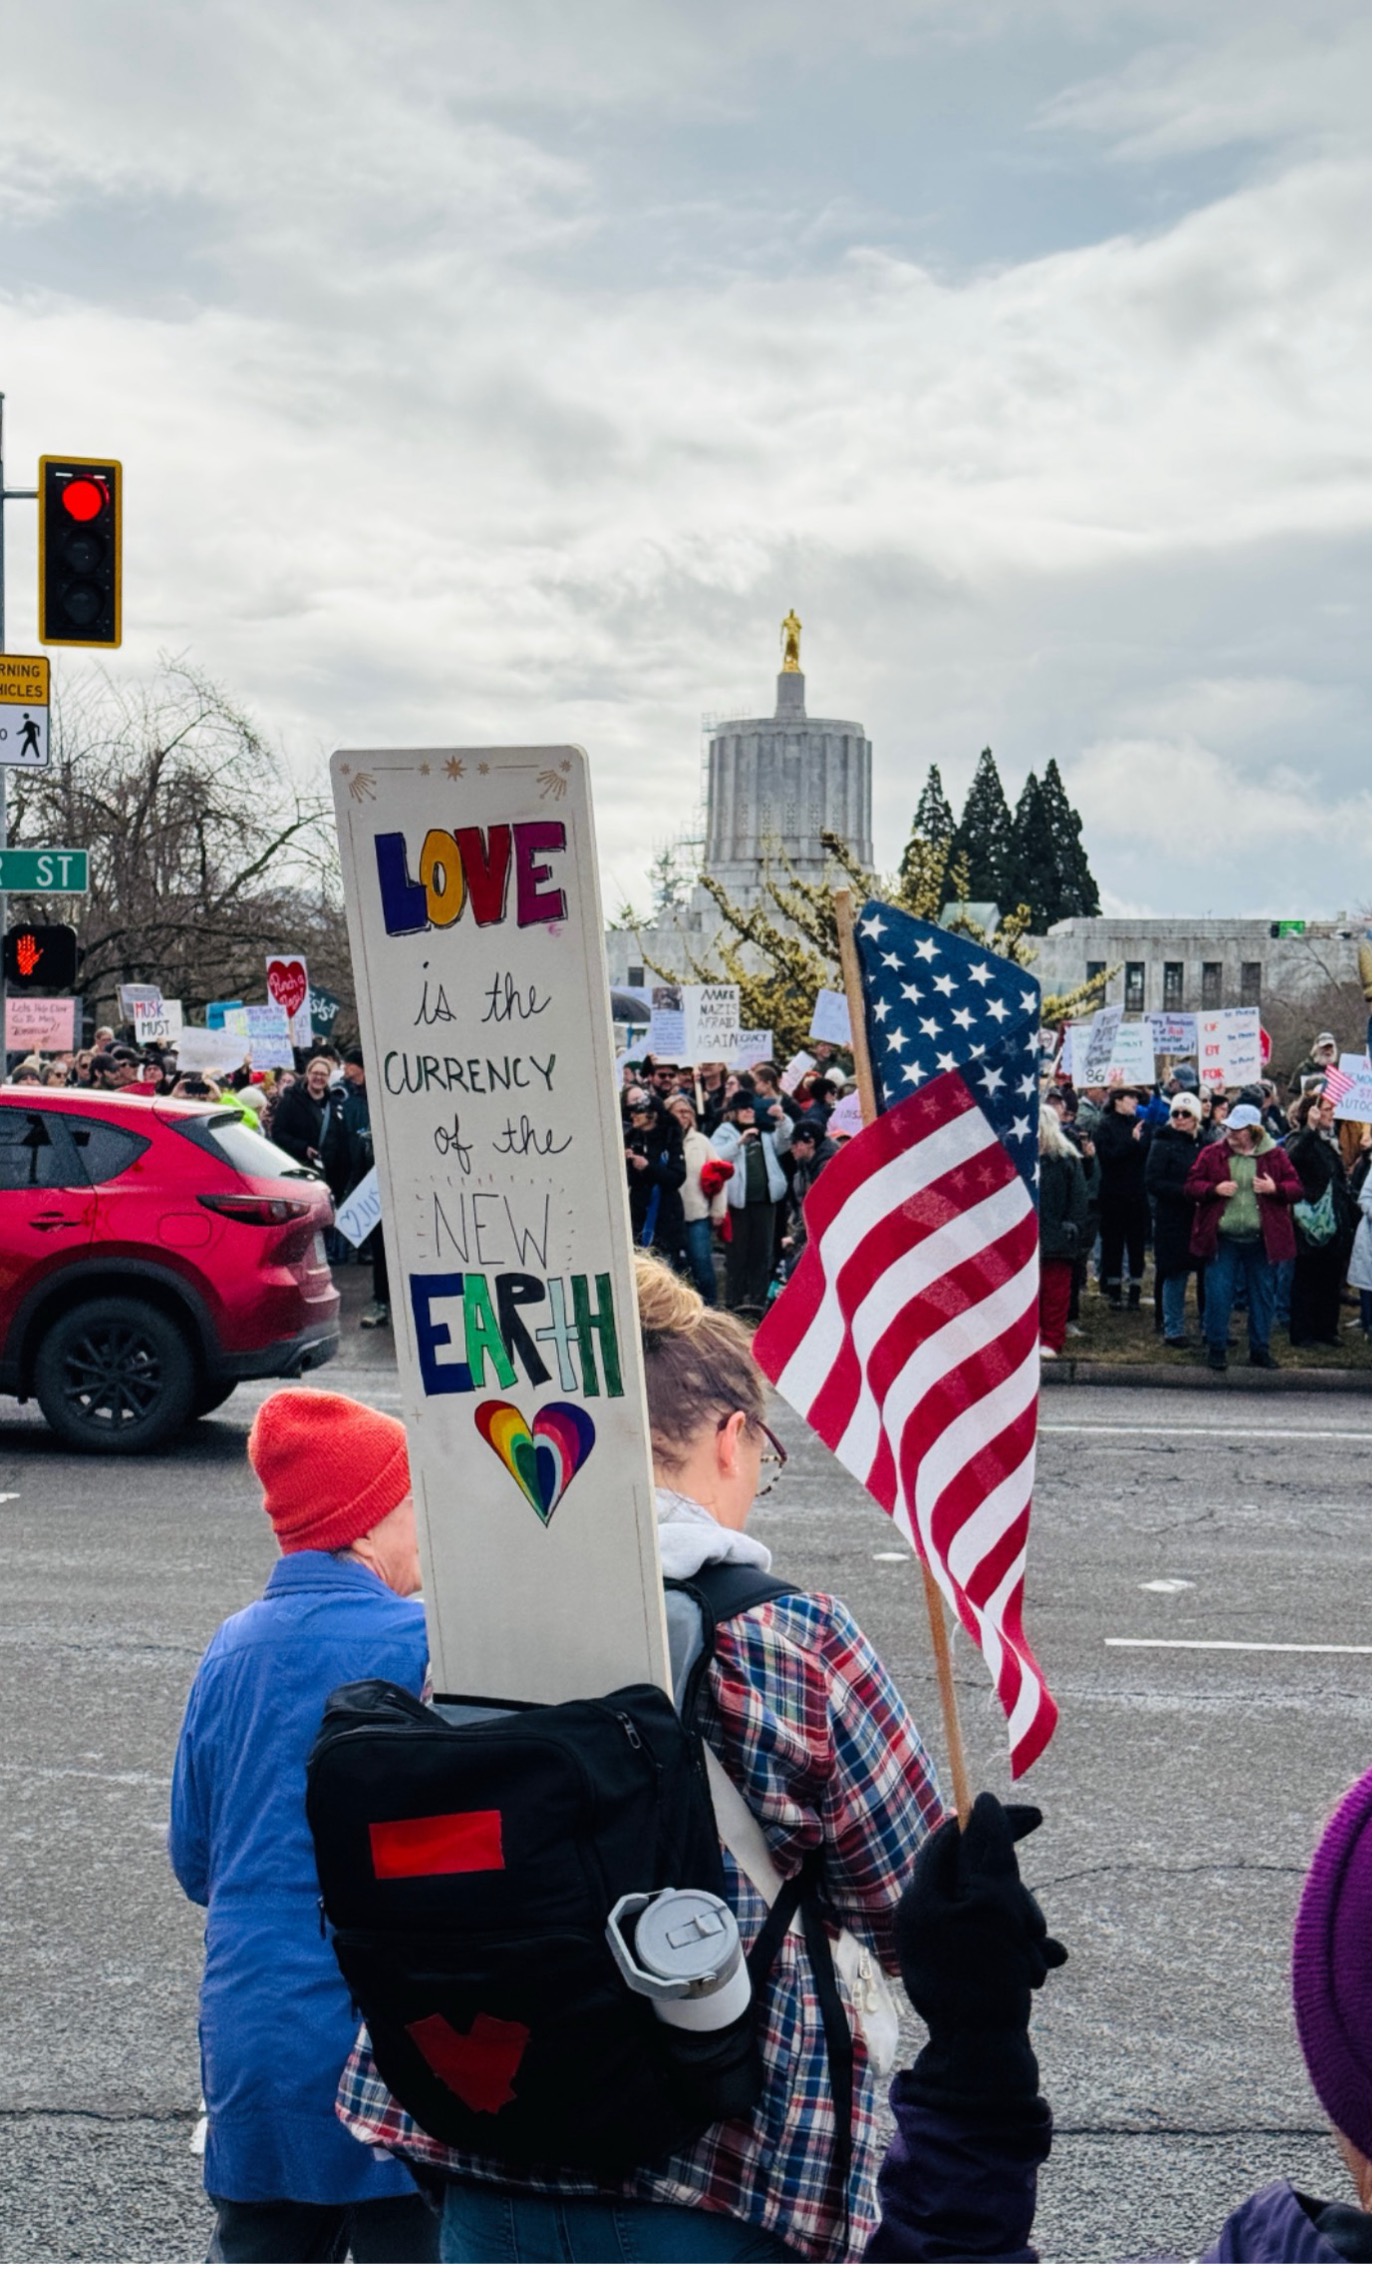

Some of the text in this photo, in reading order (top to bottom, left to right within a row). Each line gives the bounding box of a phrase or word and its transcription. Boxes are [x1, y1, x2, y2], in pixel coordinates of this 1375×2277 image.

[36, 855, 73, 888] ST
[374, 821, 568, 937] LOVE
[135, 1001, 164, 1018] MUSK
[414, 961, 551, 1026] is the
[141, 1020, 170, 1036] MUST
[384, 1051, 556, 1095] CURRENCY
[434, 1113, 572, 1174] of the
[434, 1191, 550, 1269] NEW
